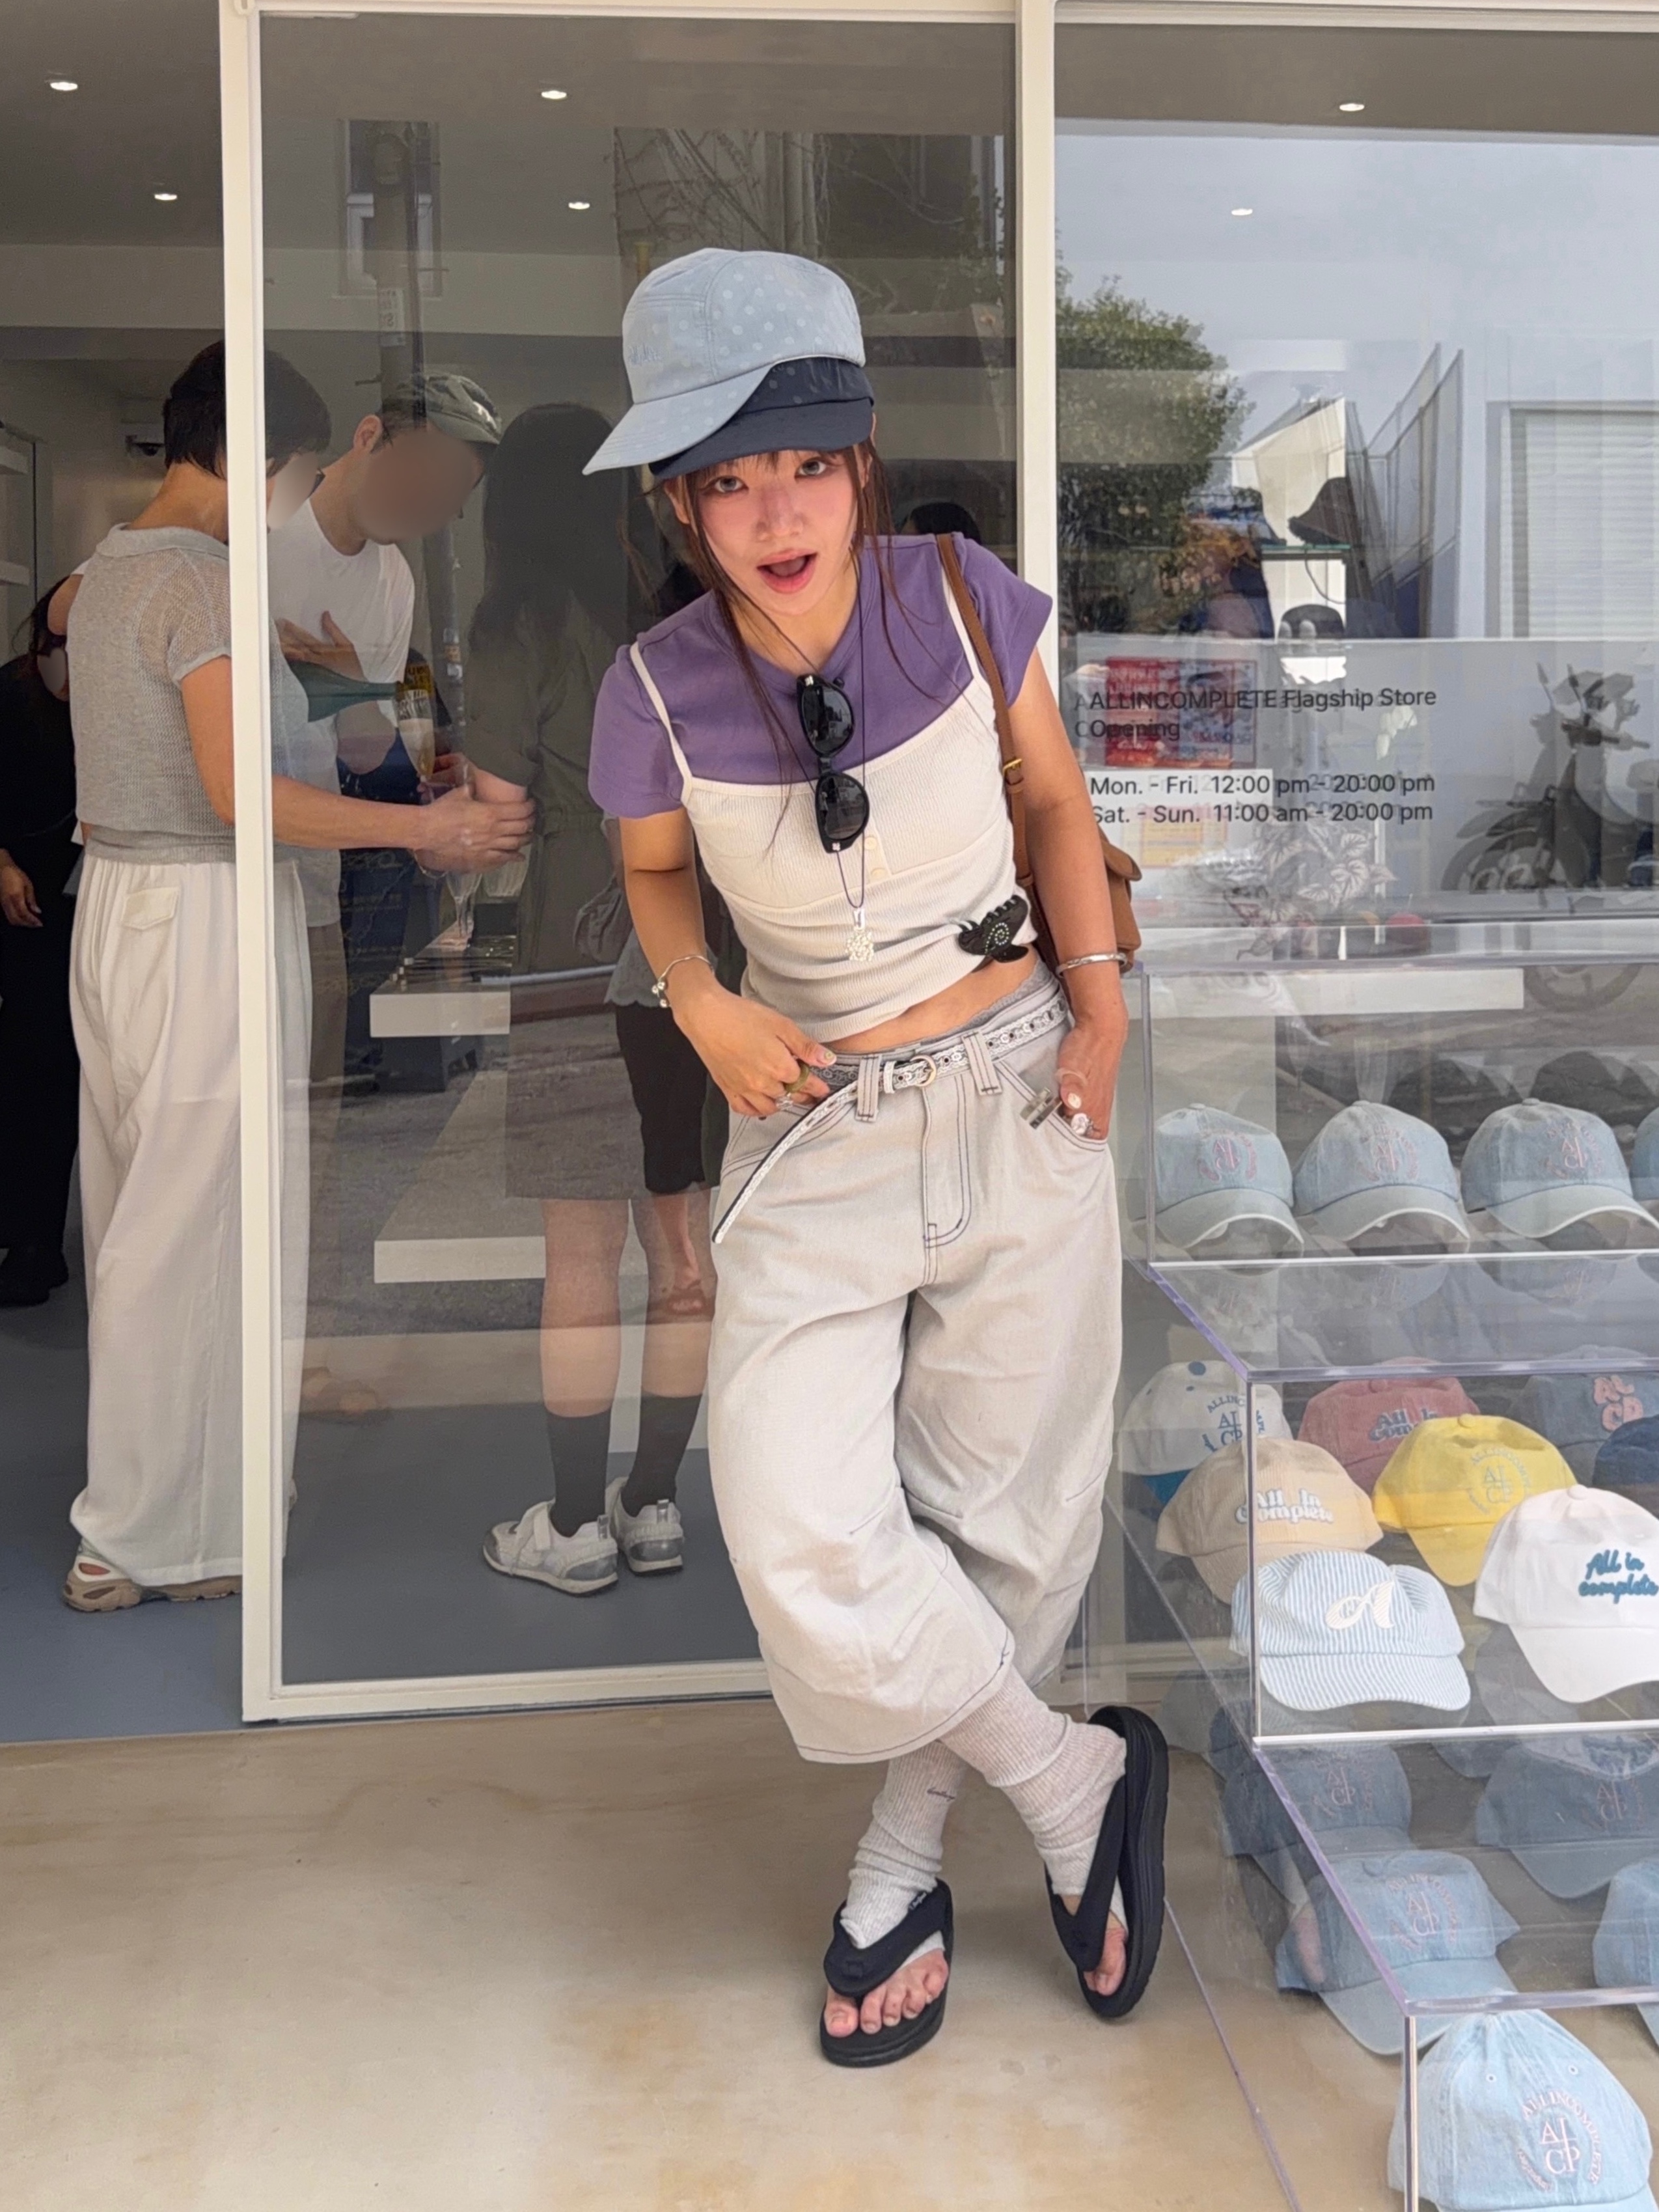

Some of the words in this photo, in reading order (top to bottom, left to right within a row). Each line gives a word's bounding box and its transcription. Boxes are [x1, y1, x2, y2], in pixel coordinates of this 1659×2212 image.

[1090, 690, 1277, 710] ALLINCOMPLETE
[1284, 688, 1373, 712] Flagship
[1380, 687, 1436, 706] Store
[1090, 719, 1180, 741] Opening
[1090, 777, 1143, 795] Mon.
[1166, 775, 1198, 794] Fri.
[1211, 775, 1270, 794] 12:00
[1276, 779, 1310, 798] pm
[1333, 774, 1395, 793] 20:00
[1402, 776, 1435, 796] pm
[1093, 805, 1130, 823] Sat.
[1153, 805, 1200, 823] Sun.
[1213, 803, 1269, 822] 11:00
[1276, 807, 1308, 822] am
[1331, 803, 1393, 822] 20:00
[1400, 805, 1433, 825] pm
[1585, 1549, 1622, 1580] All
[1625, 1551, 1645, 1571] in
[1578, 1573, 1659, 1604] complete
